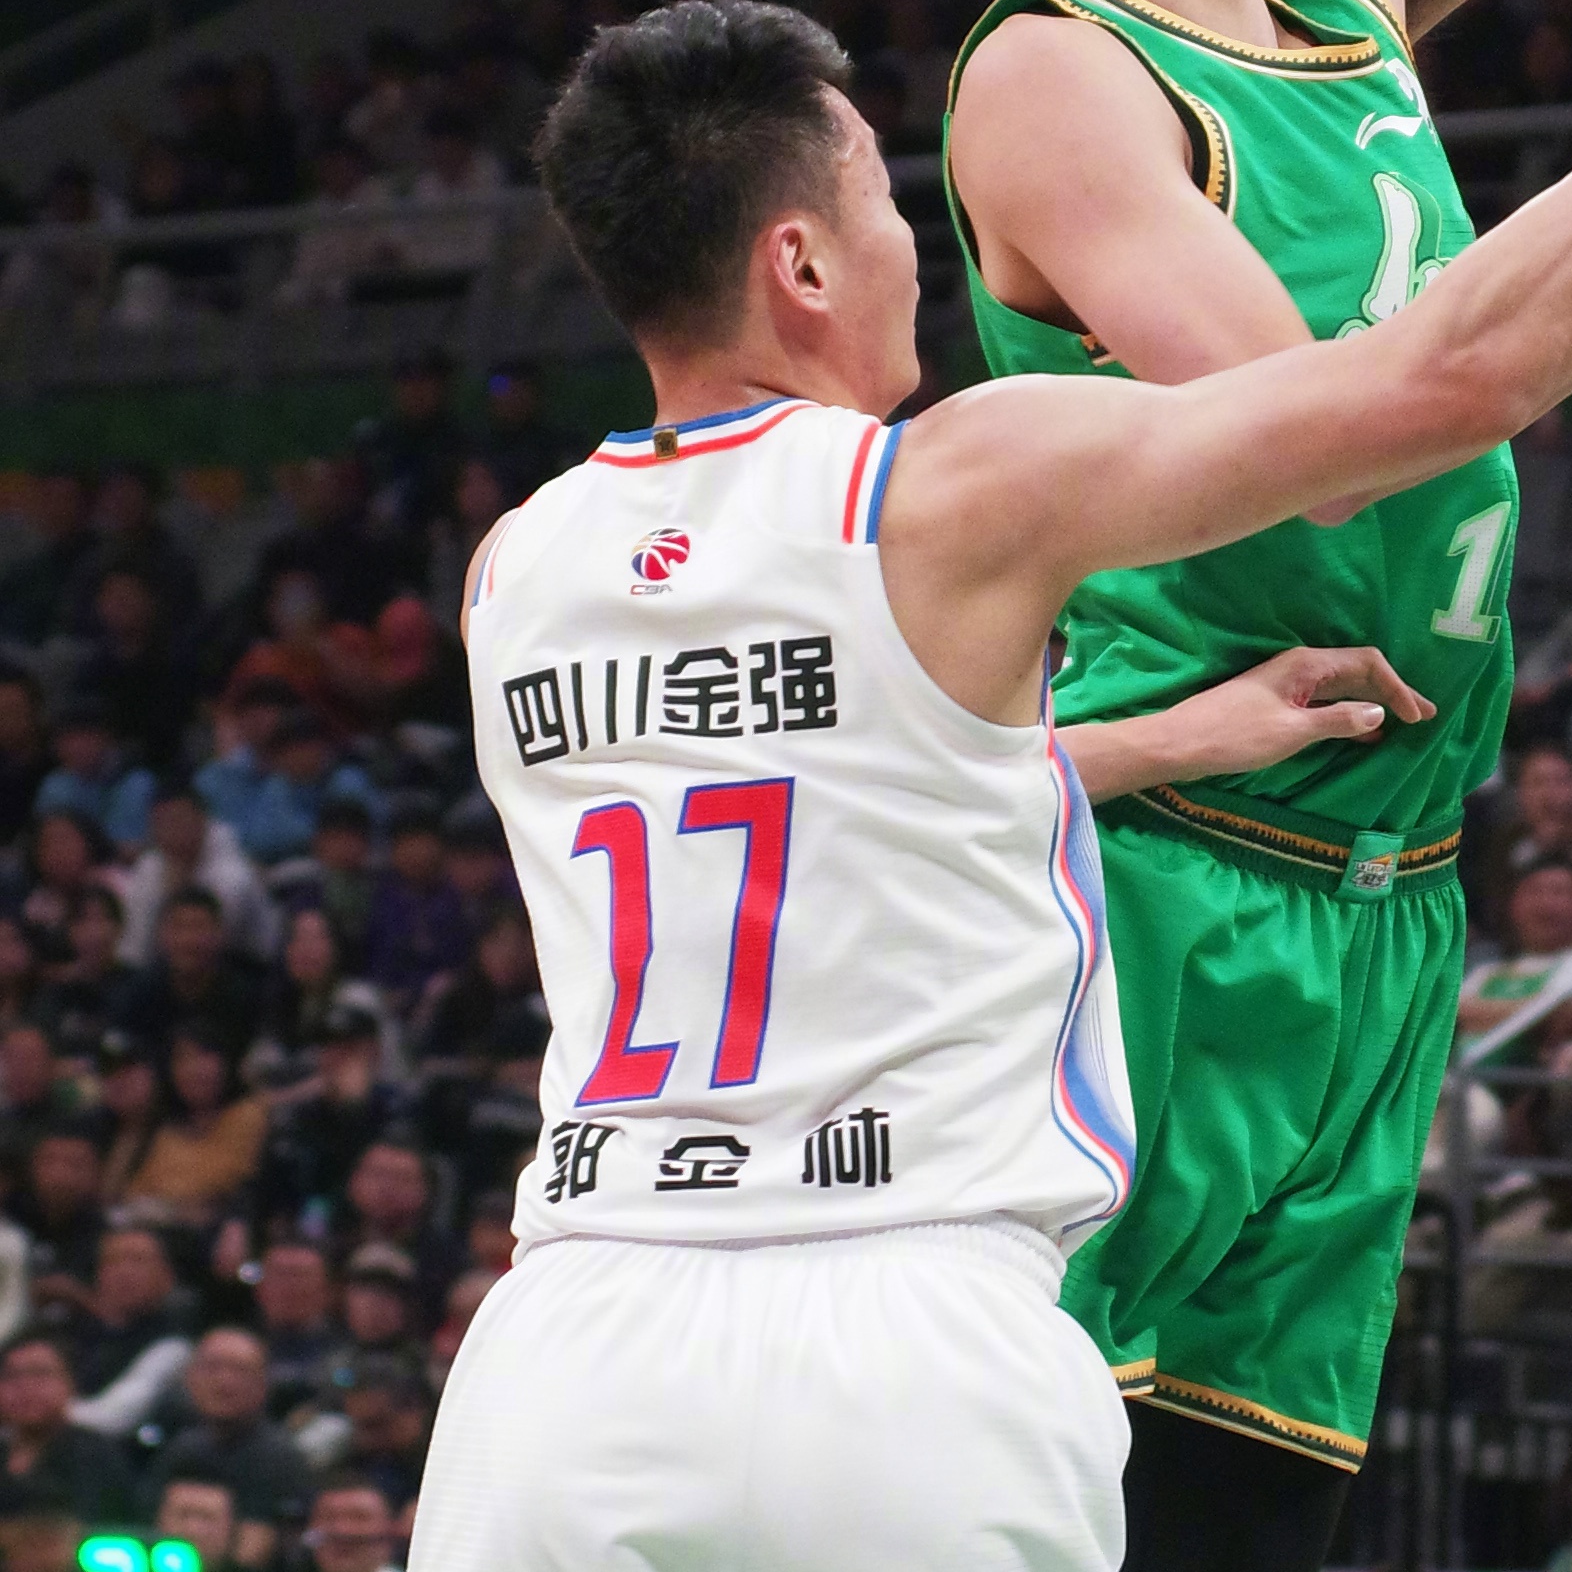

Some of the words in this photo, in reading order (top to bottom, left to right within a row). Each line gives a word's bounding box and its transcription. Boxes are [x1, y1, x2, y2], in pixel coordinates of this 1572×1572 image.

[630, 584, 673, 595] CBA
[503, 635, 838, 766] 四川金强
[571, 776, 796, 1107] 27
